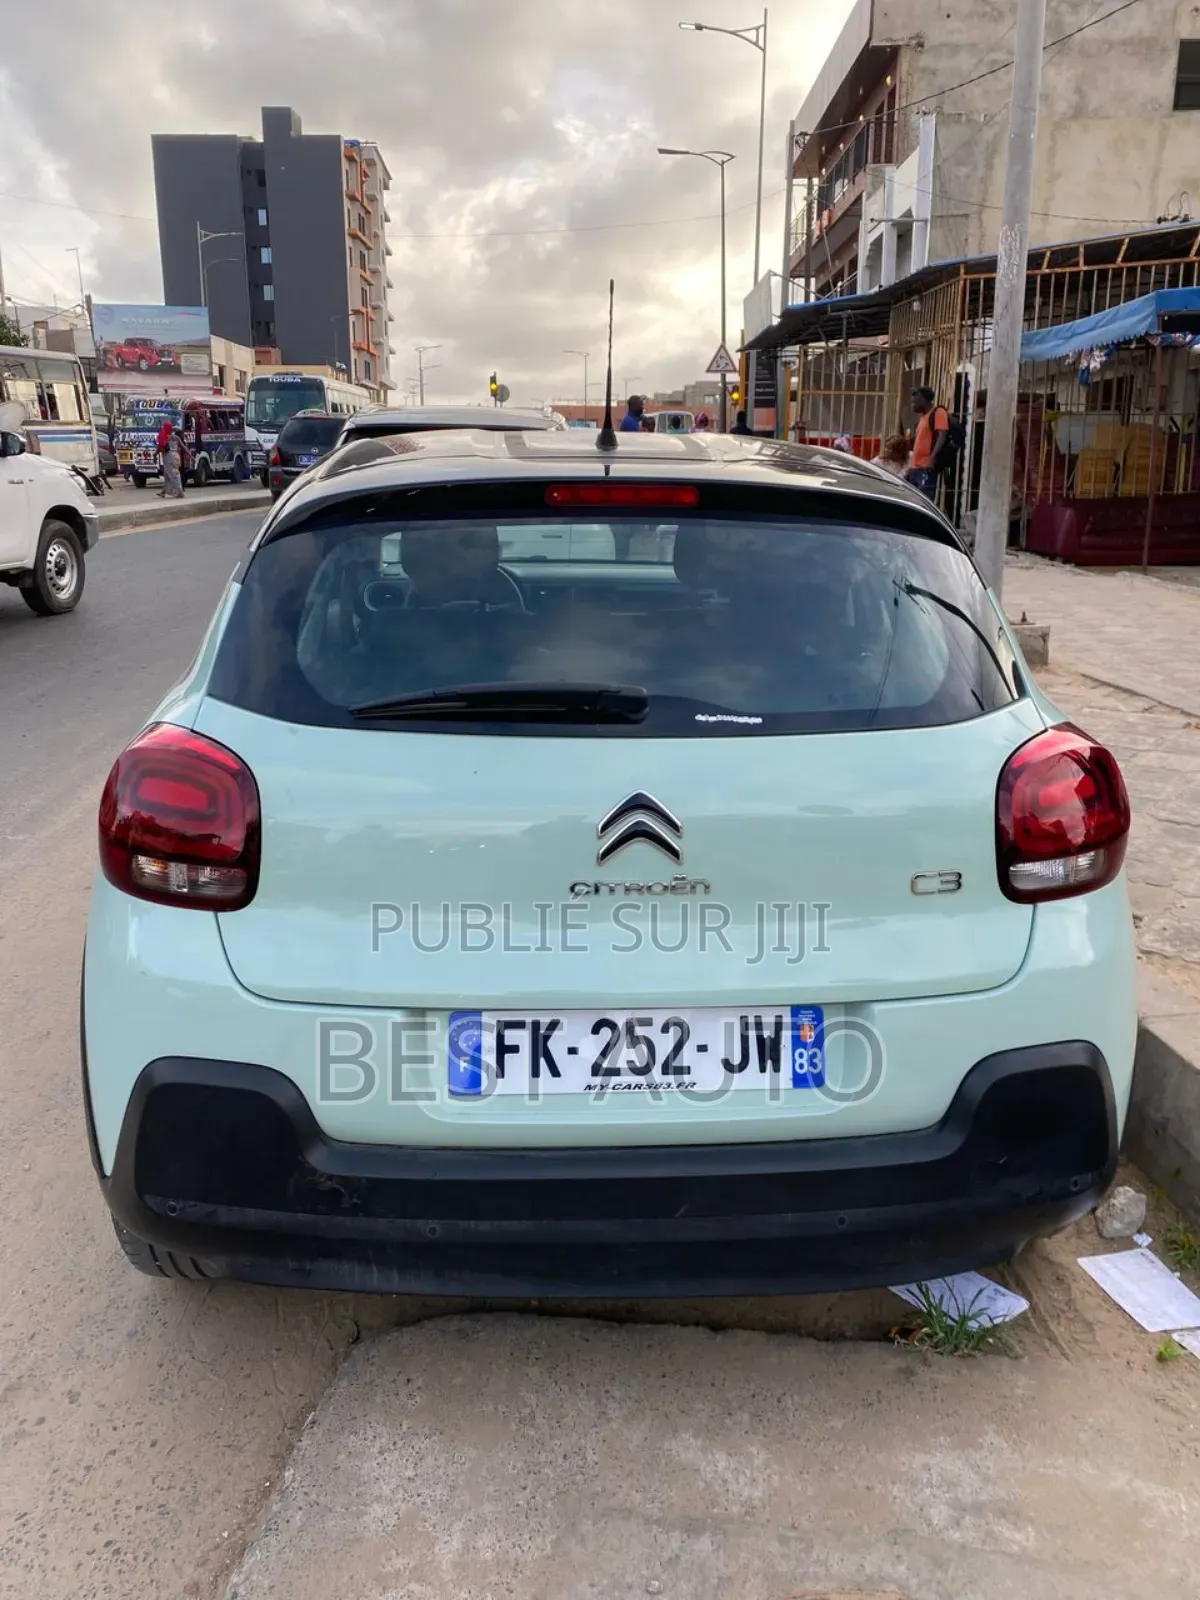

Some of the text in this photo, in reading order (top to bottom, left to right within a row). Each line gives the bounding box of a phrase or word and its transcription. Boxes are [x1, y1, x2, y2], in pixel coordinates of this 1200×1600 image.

[911, 870, 962, 895] C3
[459, 1056, 470, 1073] F
[794, 1047, 822, 1075] 83
